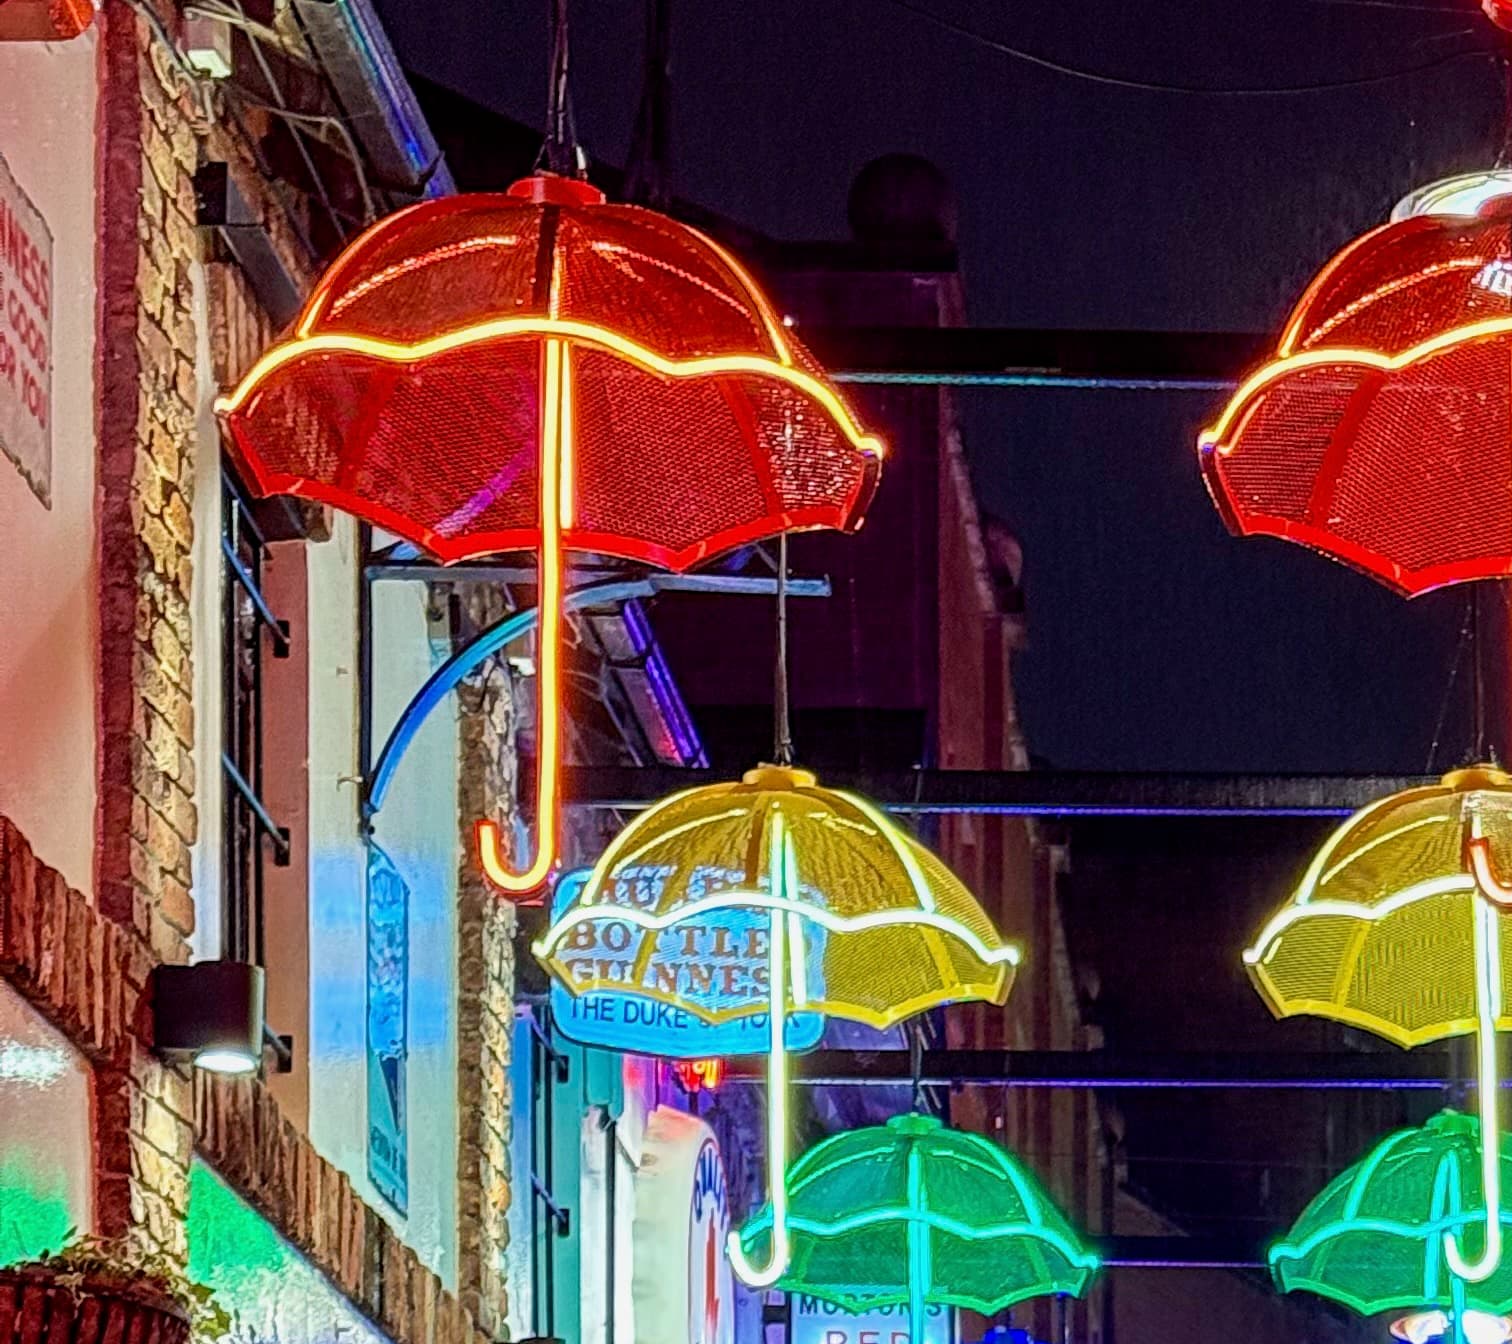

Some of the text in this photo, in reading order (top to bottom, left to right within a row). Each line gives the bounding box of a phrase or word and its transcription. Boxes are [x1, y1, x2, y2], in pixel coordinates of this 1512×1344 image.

[567, 918, 775, 964] BOTLE
[565, 957, 775, 998] GUNNES
[570, 995, 615, 1023] THE
[623, 1000, 689, 1029] DUKE
